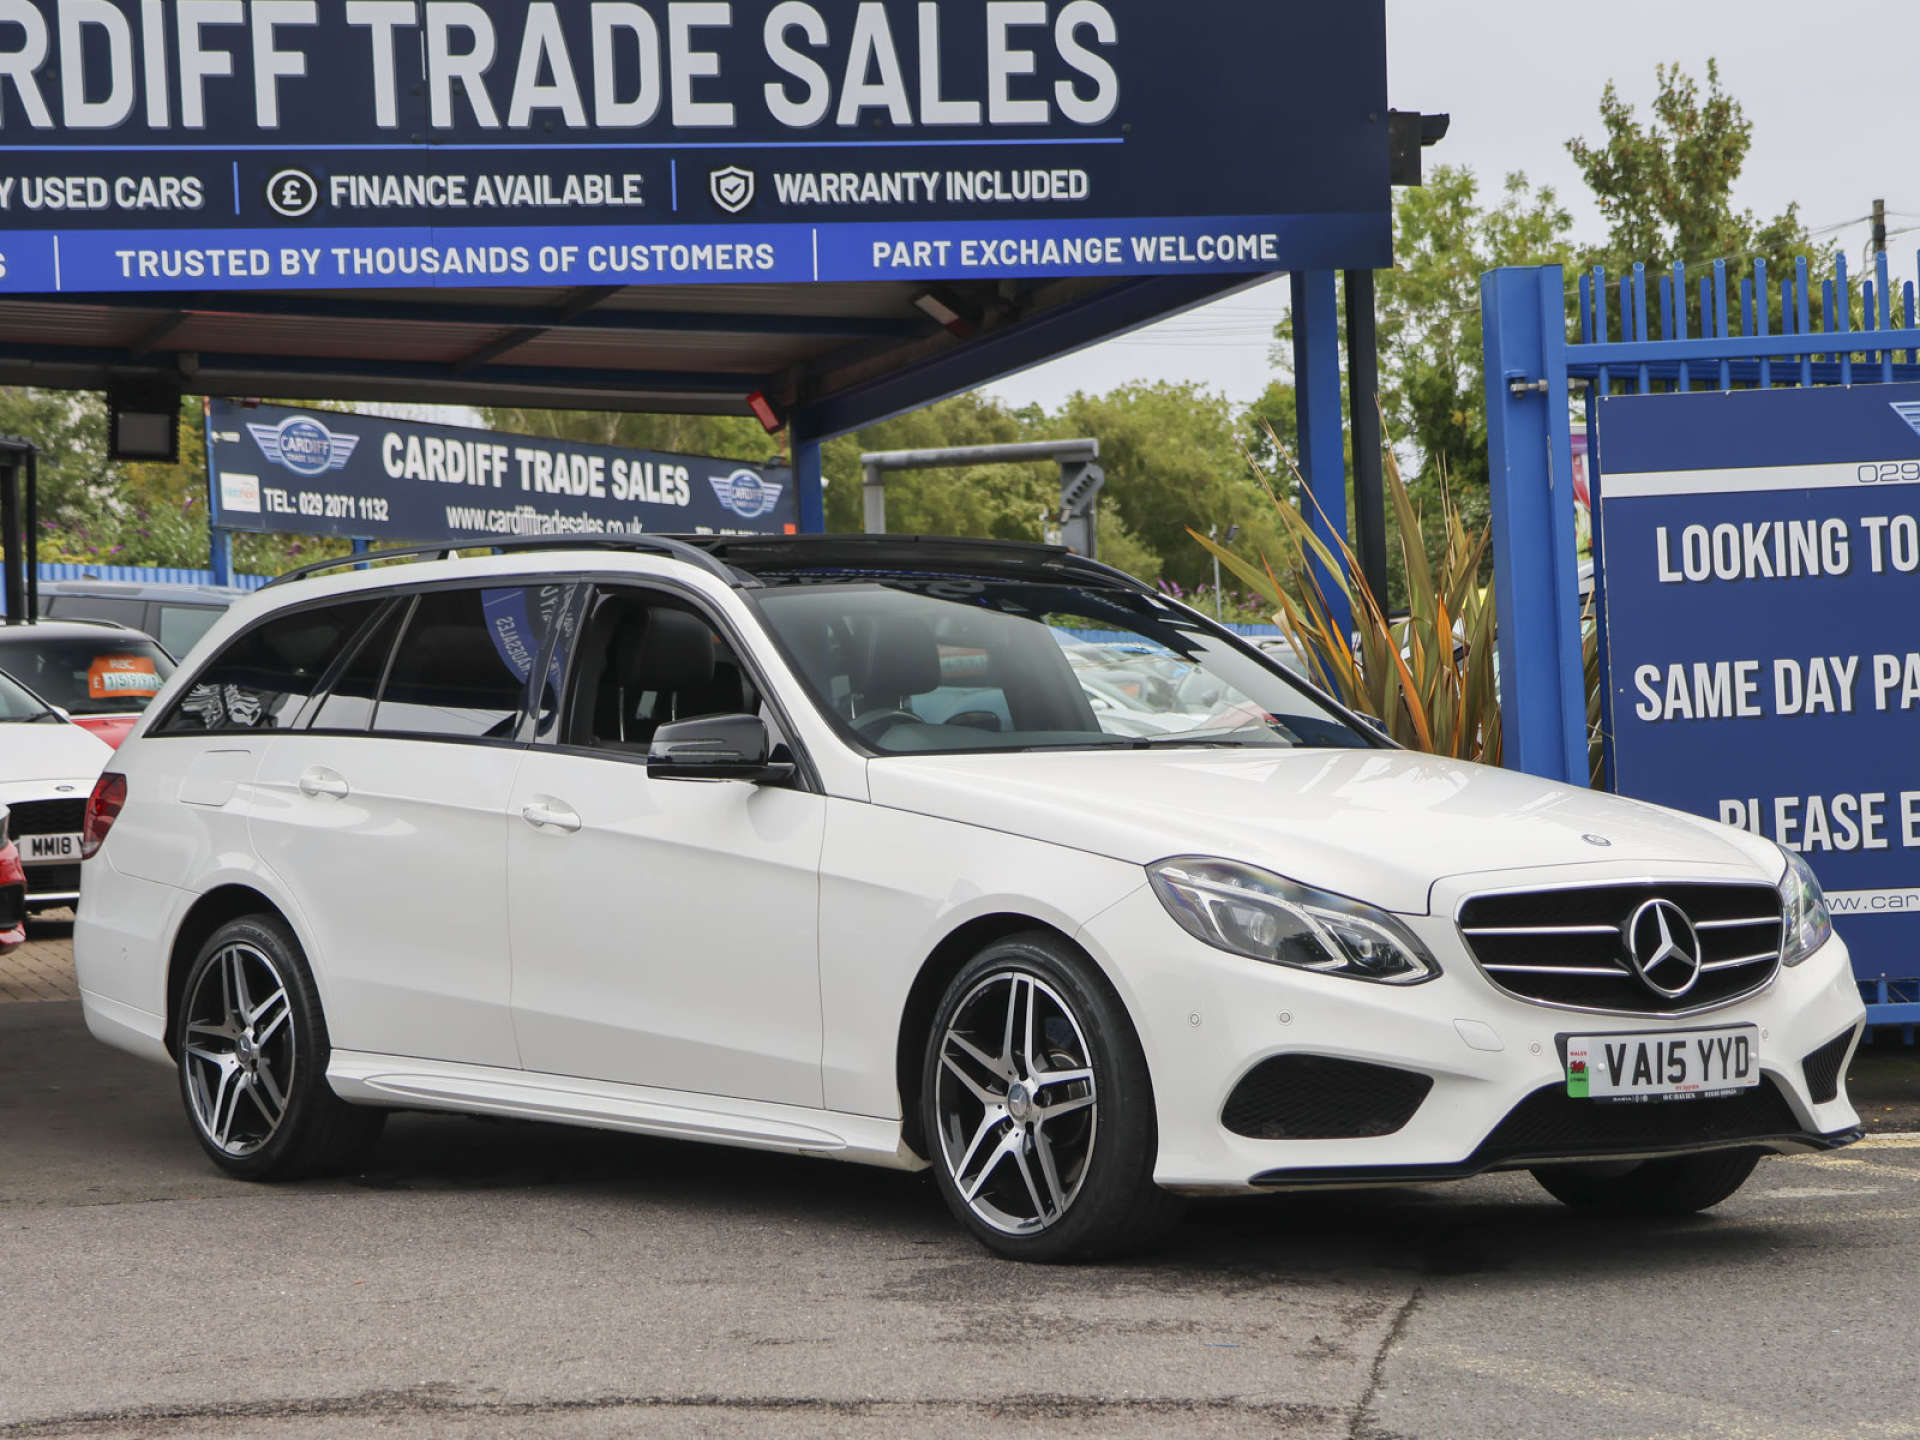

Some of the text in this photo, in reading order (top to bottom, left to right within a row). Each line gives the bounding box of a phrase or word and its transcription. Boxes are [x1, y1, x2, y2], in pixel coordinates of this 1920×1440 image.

[346, 0, 736, 128] TRADE
[764, 0, 1119, 126] SALES
[21, 176, 110, 209] USED
[115, 177, 203, 209] CARS
[330, 174, 644, 207] FINANCE AVAILABLE
[773, 170, 1089, 204] WARRANTY INCLUDED
[115, 243, 775, 278] TRUSTED BY THOUSANDS OF CUSTOMERS
[872, 234, 1279, 268] PART EXCHANGE WELCOME
[382, 432, 691, 507] CARDIFF TRADE SALES
[1857, 463, 1920, 483] 029
[263, 487, 297, 514] TEL:
[299, 491, 324, 517] 029
[325, 494, 356, 519] 2071
[358, 497, 389, 521] 1132
[1656, 514, 1919, 583] LOOKING TO
[1634, 660, 1762, 721] SAME
[1773, 655, 1859, 715] DAY
[31, 836, 72, 857] MM18
[1604, 1035, 1749, 1087] VA15 YYD
